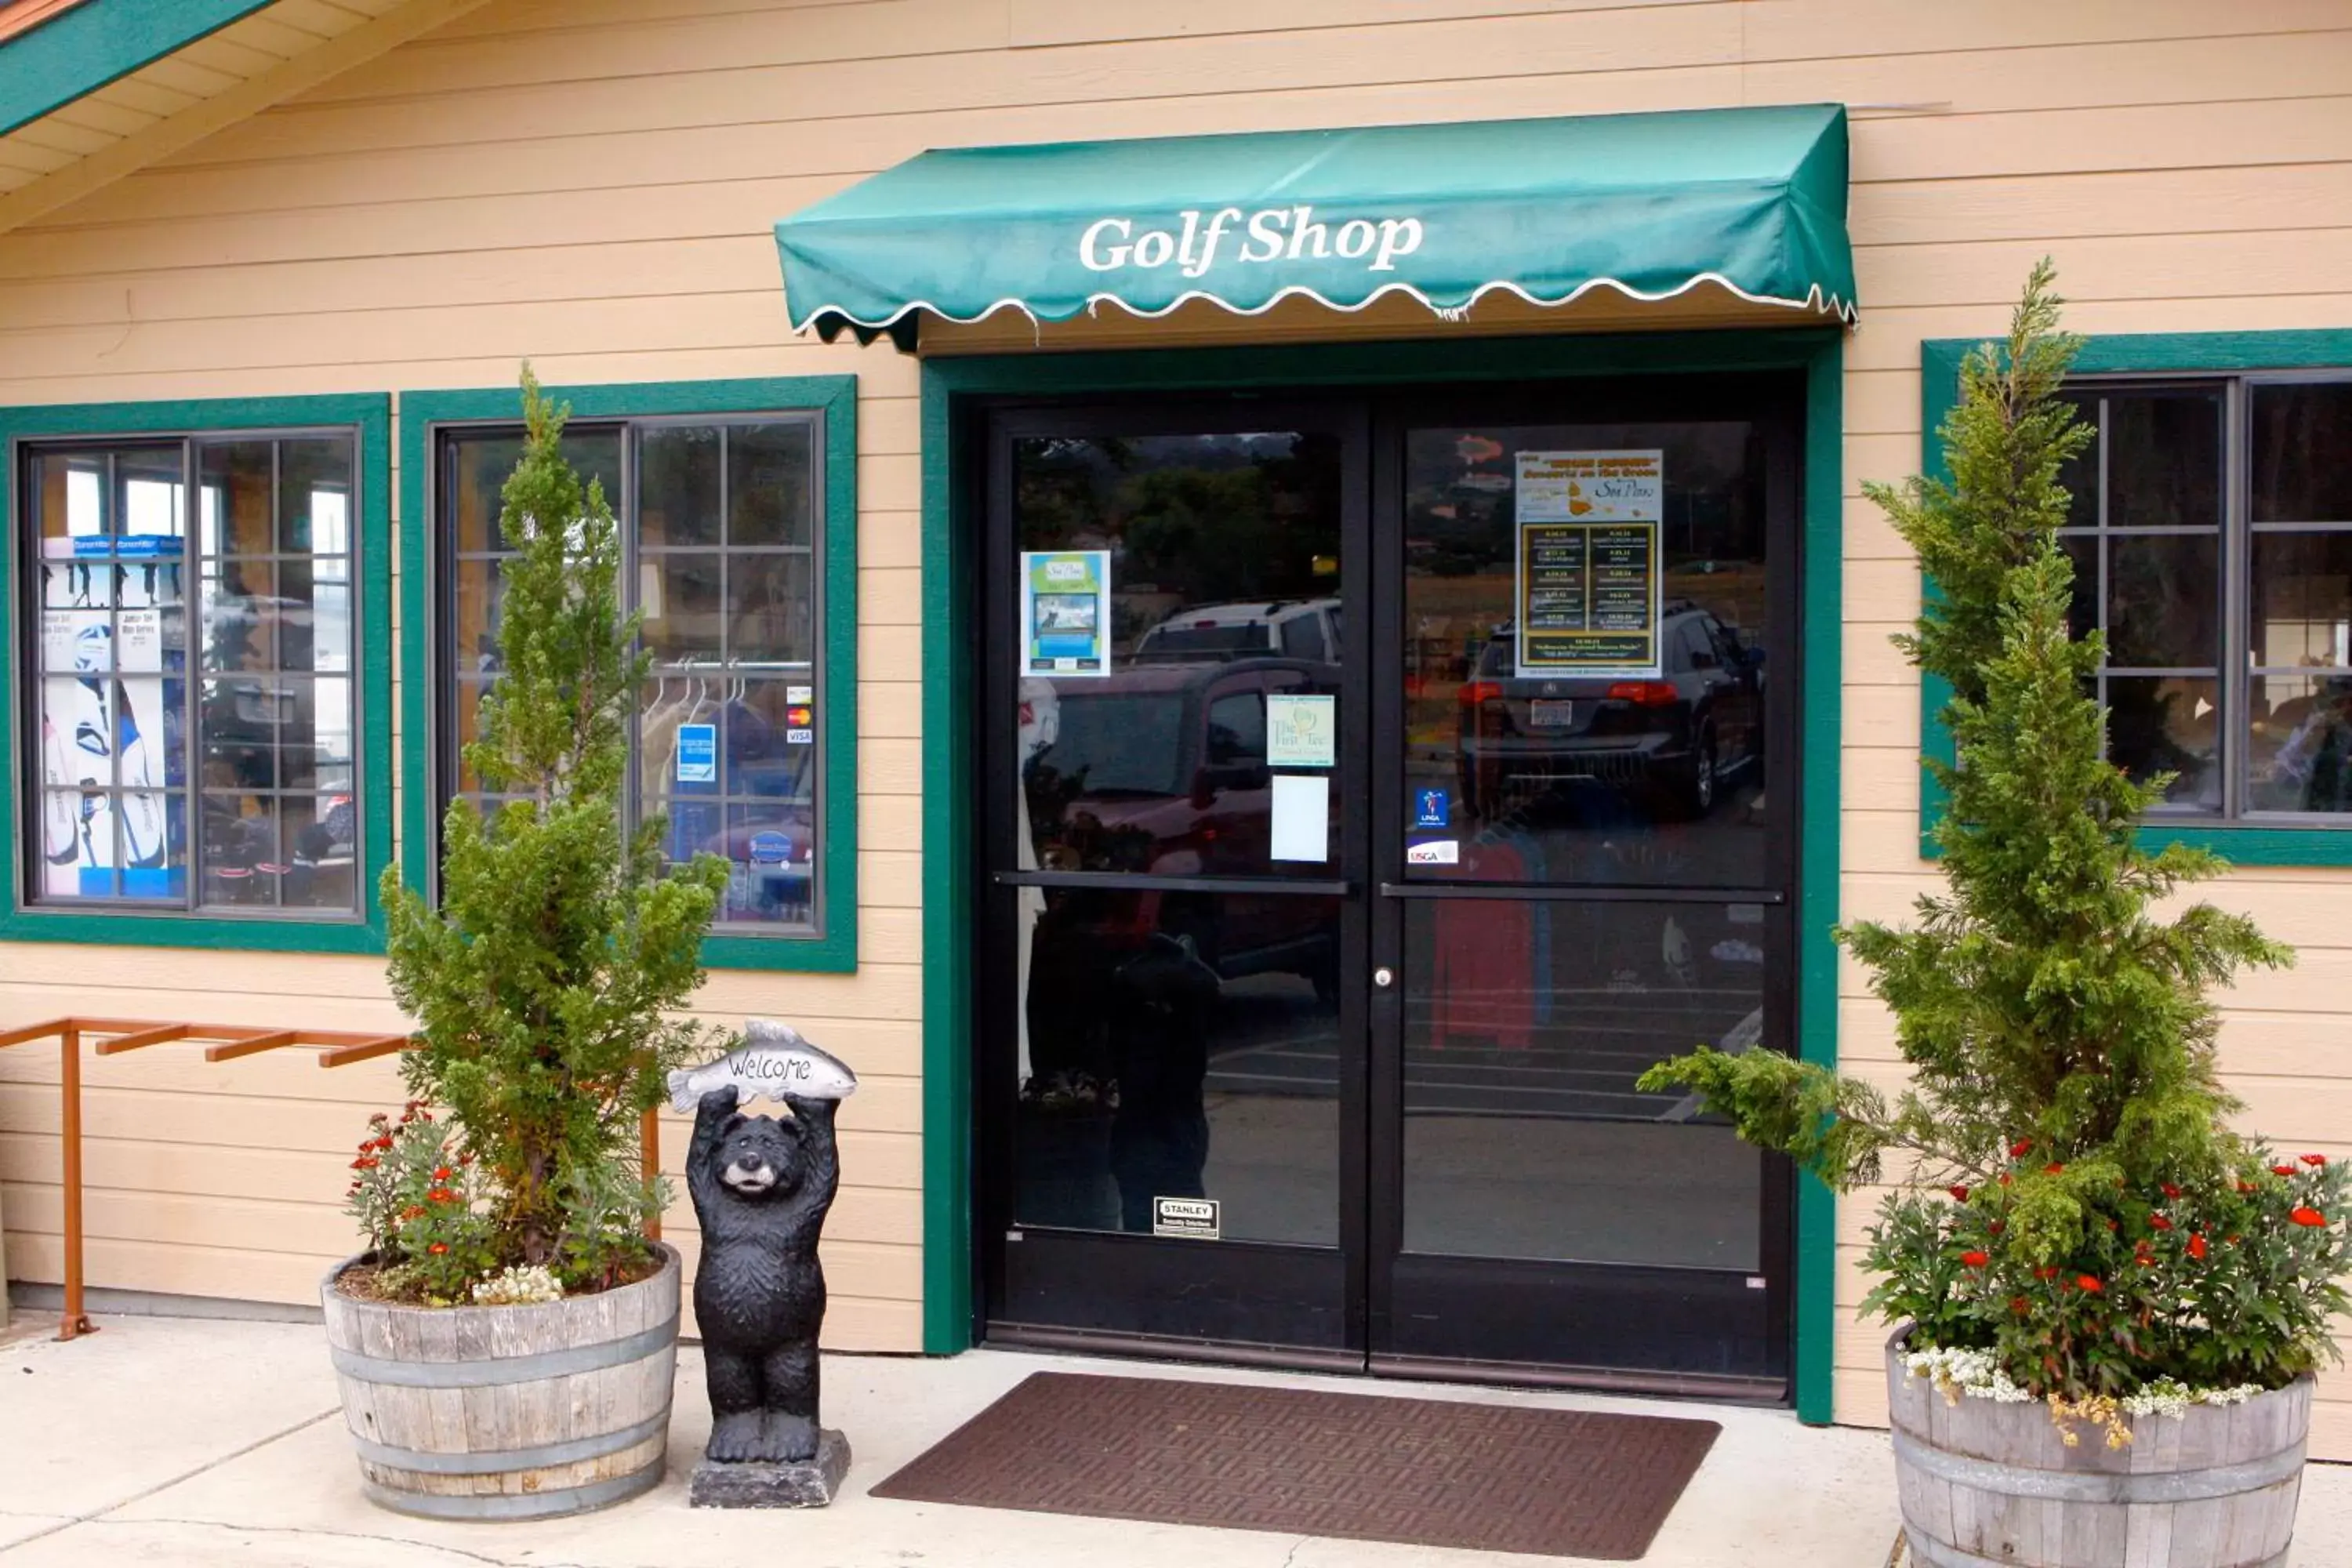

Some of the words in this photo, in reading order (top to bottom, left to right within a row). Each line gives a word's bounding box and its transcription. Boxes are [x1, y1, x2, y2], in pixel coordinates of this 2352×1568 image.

[1080, 207, 1242, 278] Golf
[1238, 204, 1423, 271] Shop
[789, 731, 810, 741] VISA
[1410, 851, 1438, 861] USGA
[1164, 1204, 1208, 1215] STANLEY
